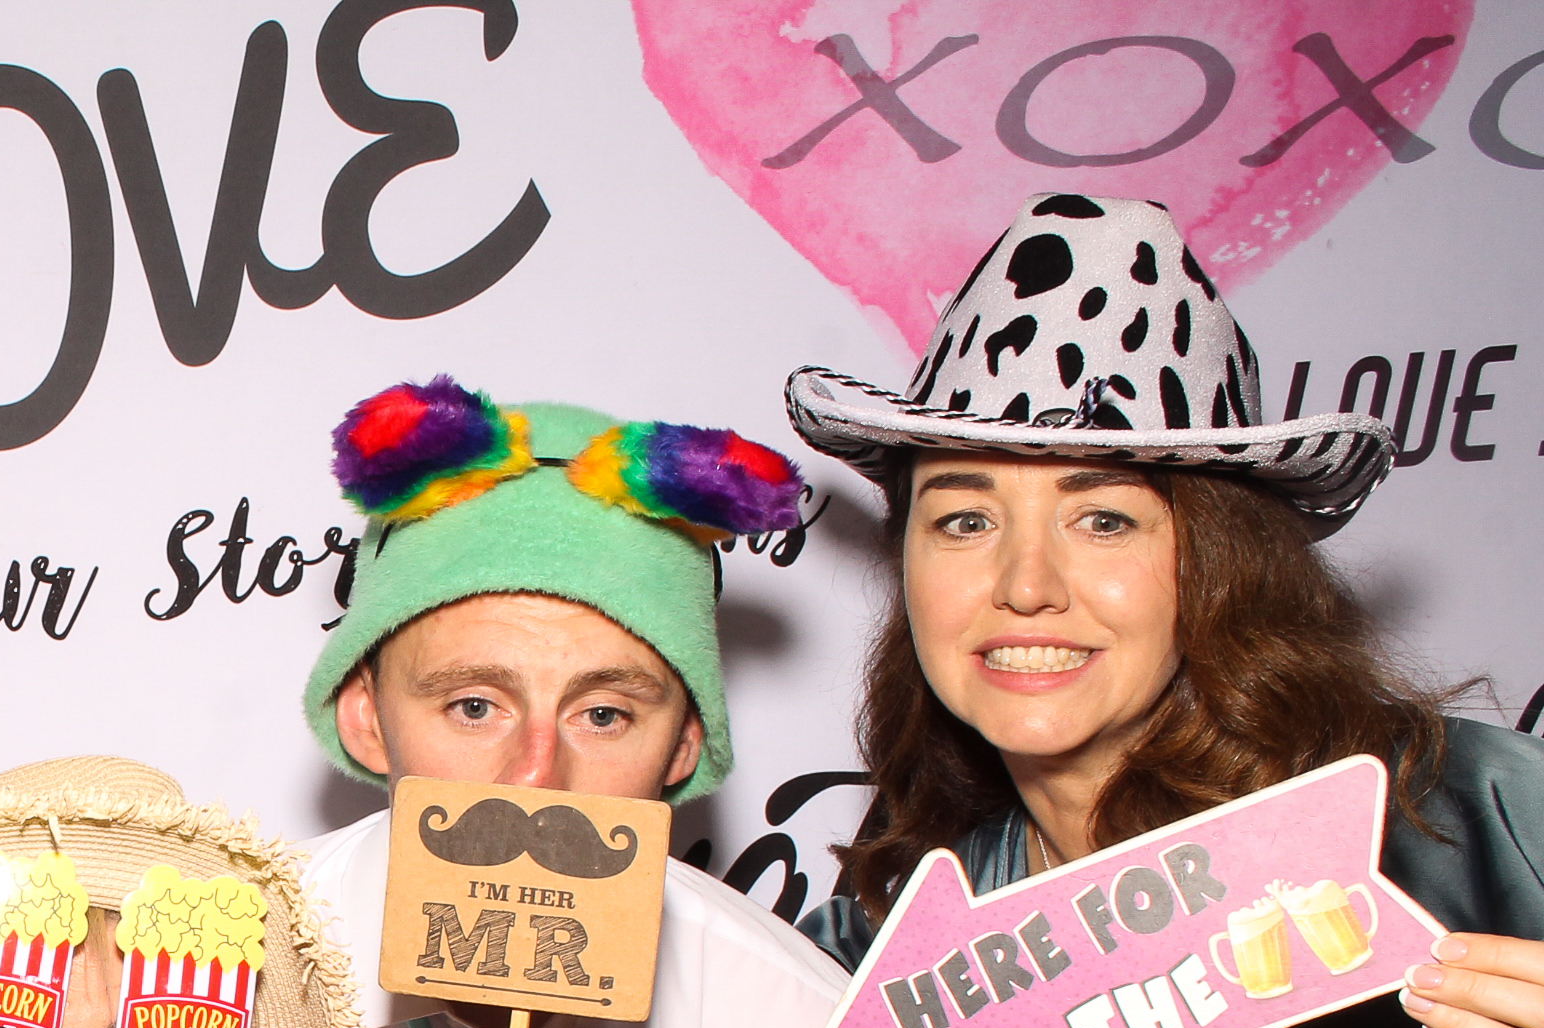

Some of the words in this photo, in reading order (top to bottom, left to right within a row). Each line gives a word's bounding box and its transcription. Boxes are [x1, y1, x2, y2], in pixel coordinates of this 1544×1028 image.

[143, 495, 362, 633] Stor
[416, 901, 615, 990] MR.
[466, 879, 511, 902] I'M
[517, 885, 576, 910] HER
[1070, 841, 1228, 956] FOR
